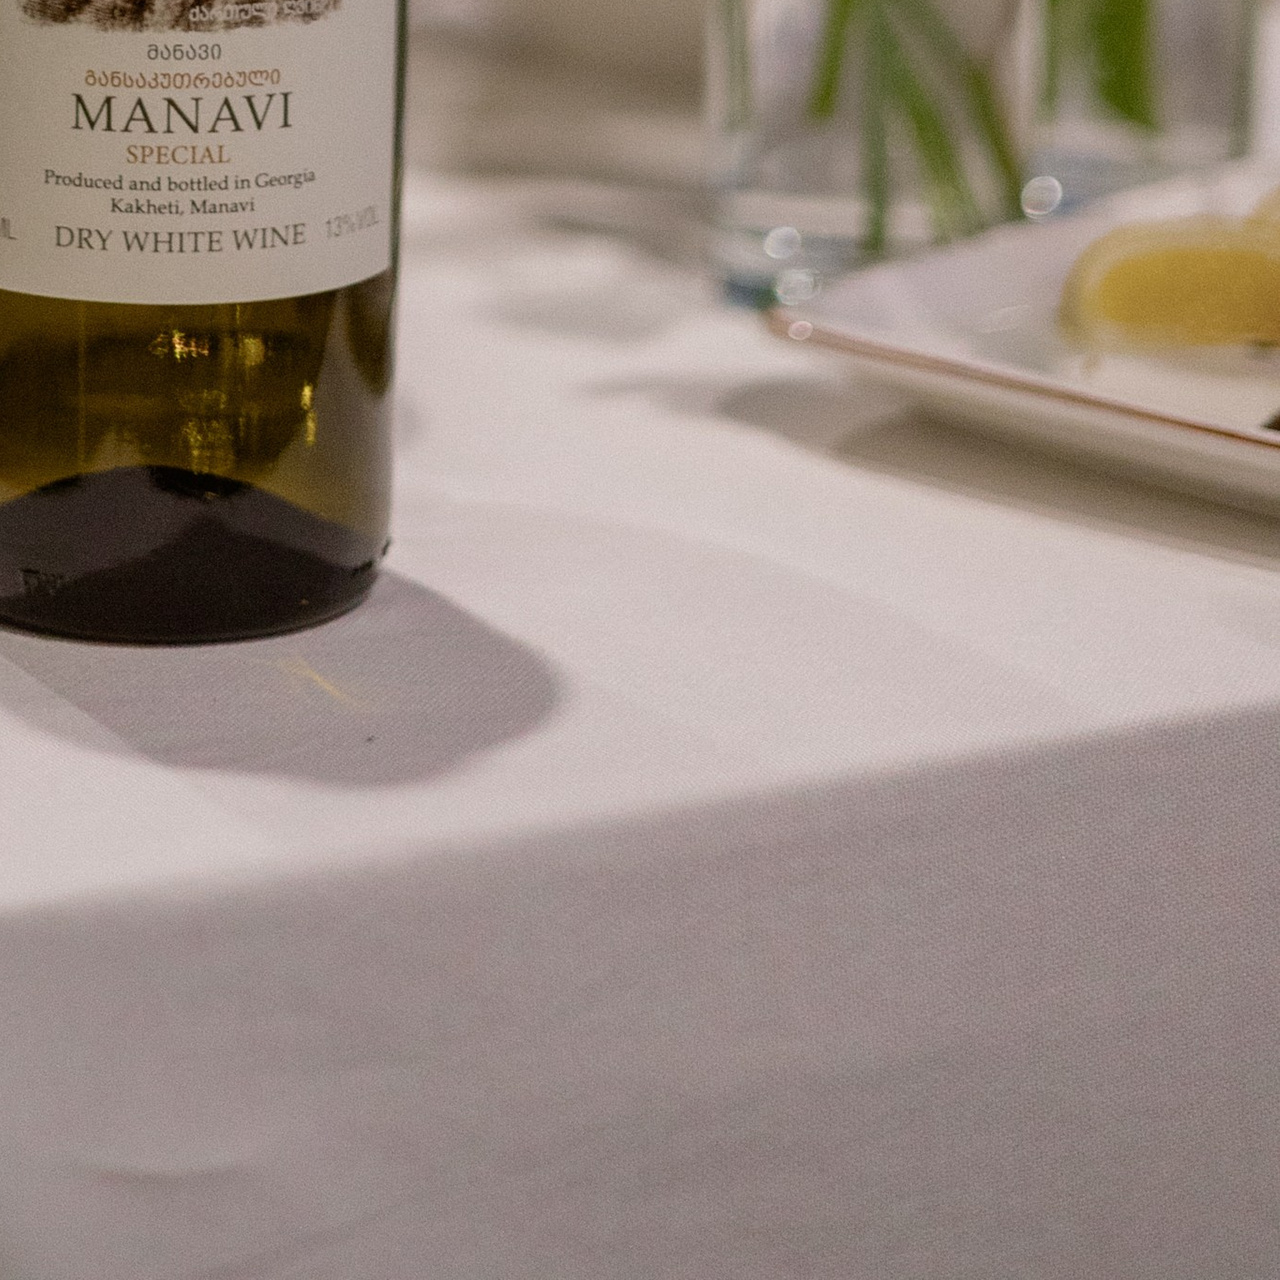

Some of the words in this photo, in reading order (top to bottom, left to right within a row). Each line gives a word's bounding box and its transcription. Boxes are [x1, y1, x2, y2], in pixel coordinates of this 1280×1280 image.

[146, 42, 223, 62] მანავი
[84, 67, 282, 90] განსაკუთრებული
[71, 91, 292, 135] MANAVI
[126, 144, 231, 166] SPECIAL
[43, 168, 124, 191] Produced
[128, 175, 162, 193] and
[166, 174, 230, 193] bottled
[233, 174, 252, 191] in
[253, 170, 317, 190] Georgia
[110, 197, 185, 216] Kakheti,
[189, 198, 255, 215] Manavi
[54, 225, 113, 252] DRY
[121, 230, 224, 254] WHITE
[231, 222, 306, 251] WINE
